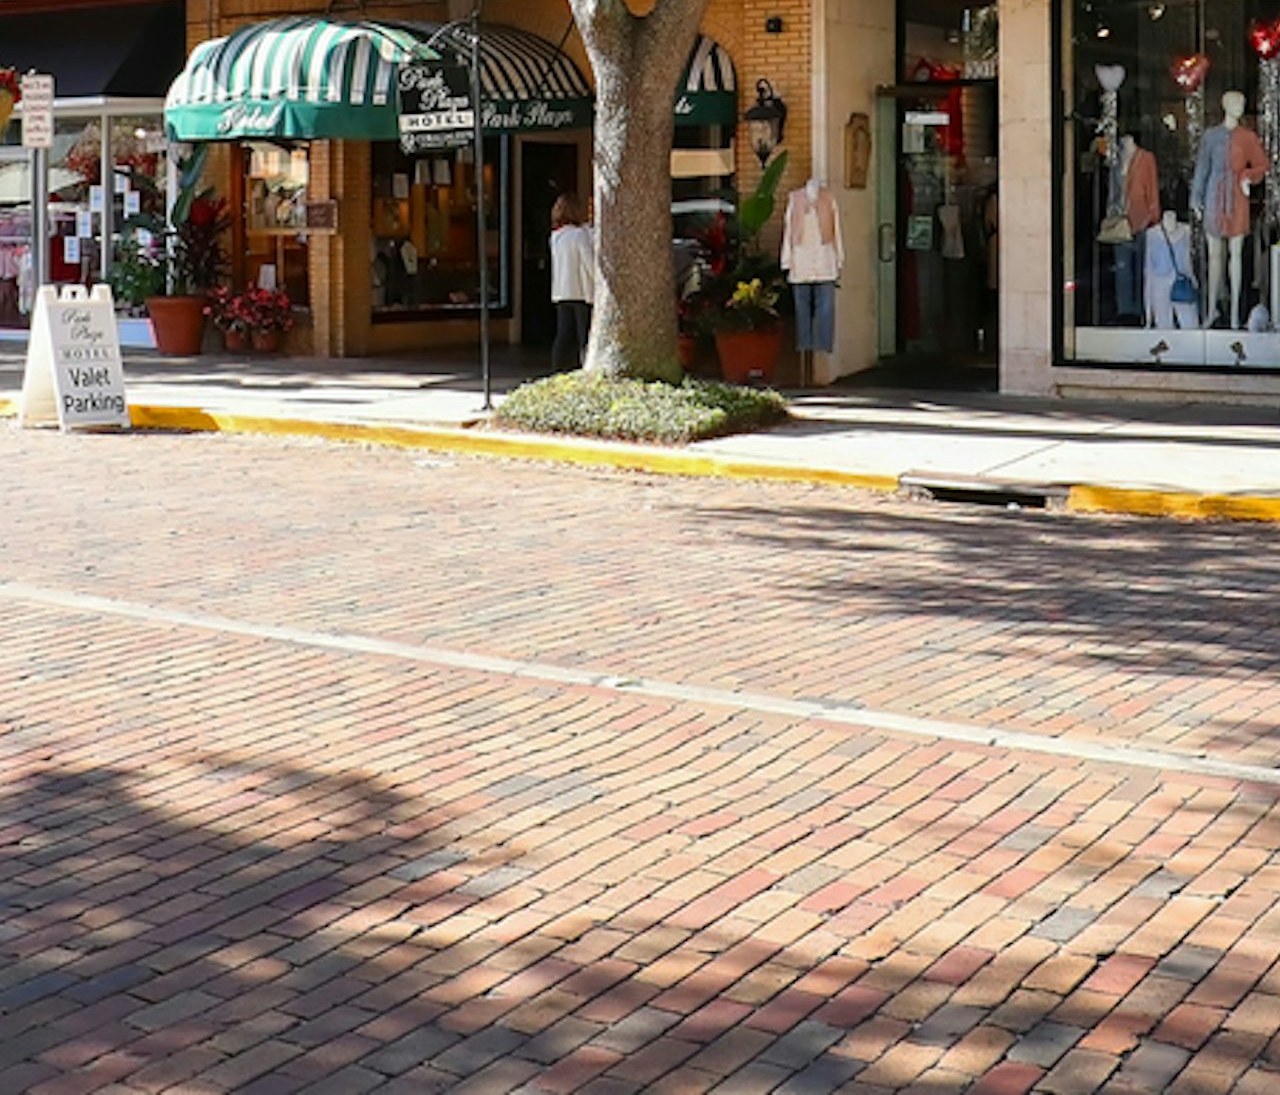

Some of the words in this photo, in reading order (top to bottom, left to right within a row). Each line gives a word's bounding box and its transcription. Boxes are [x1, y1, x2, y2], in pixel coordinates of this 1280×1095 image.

[399, 65, 445, 92] Park
[418, 86, 469, 118] Plaza
[216, 101, 284, 133] Hotel
[408, 114, 466, 127] HOTEL
[481, 102, 522, 128] Park
[523, 102, 574, 128] Plaza
[62, 307, 92, 324] Park
[70, 325, 104, 346] Plaza
[63, 348, 110, 359] HOTEL
[68, 367, 112, 387] Valet
[63, 392, 125, 414] Parking
